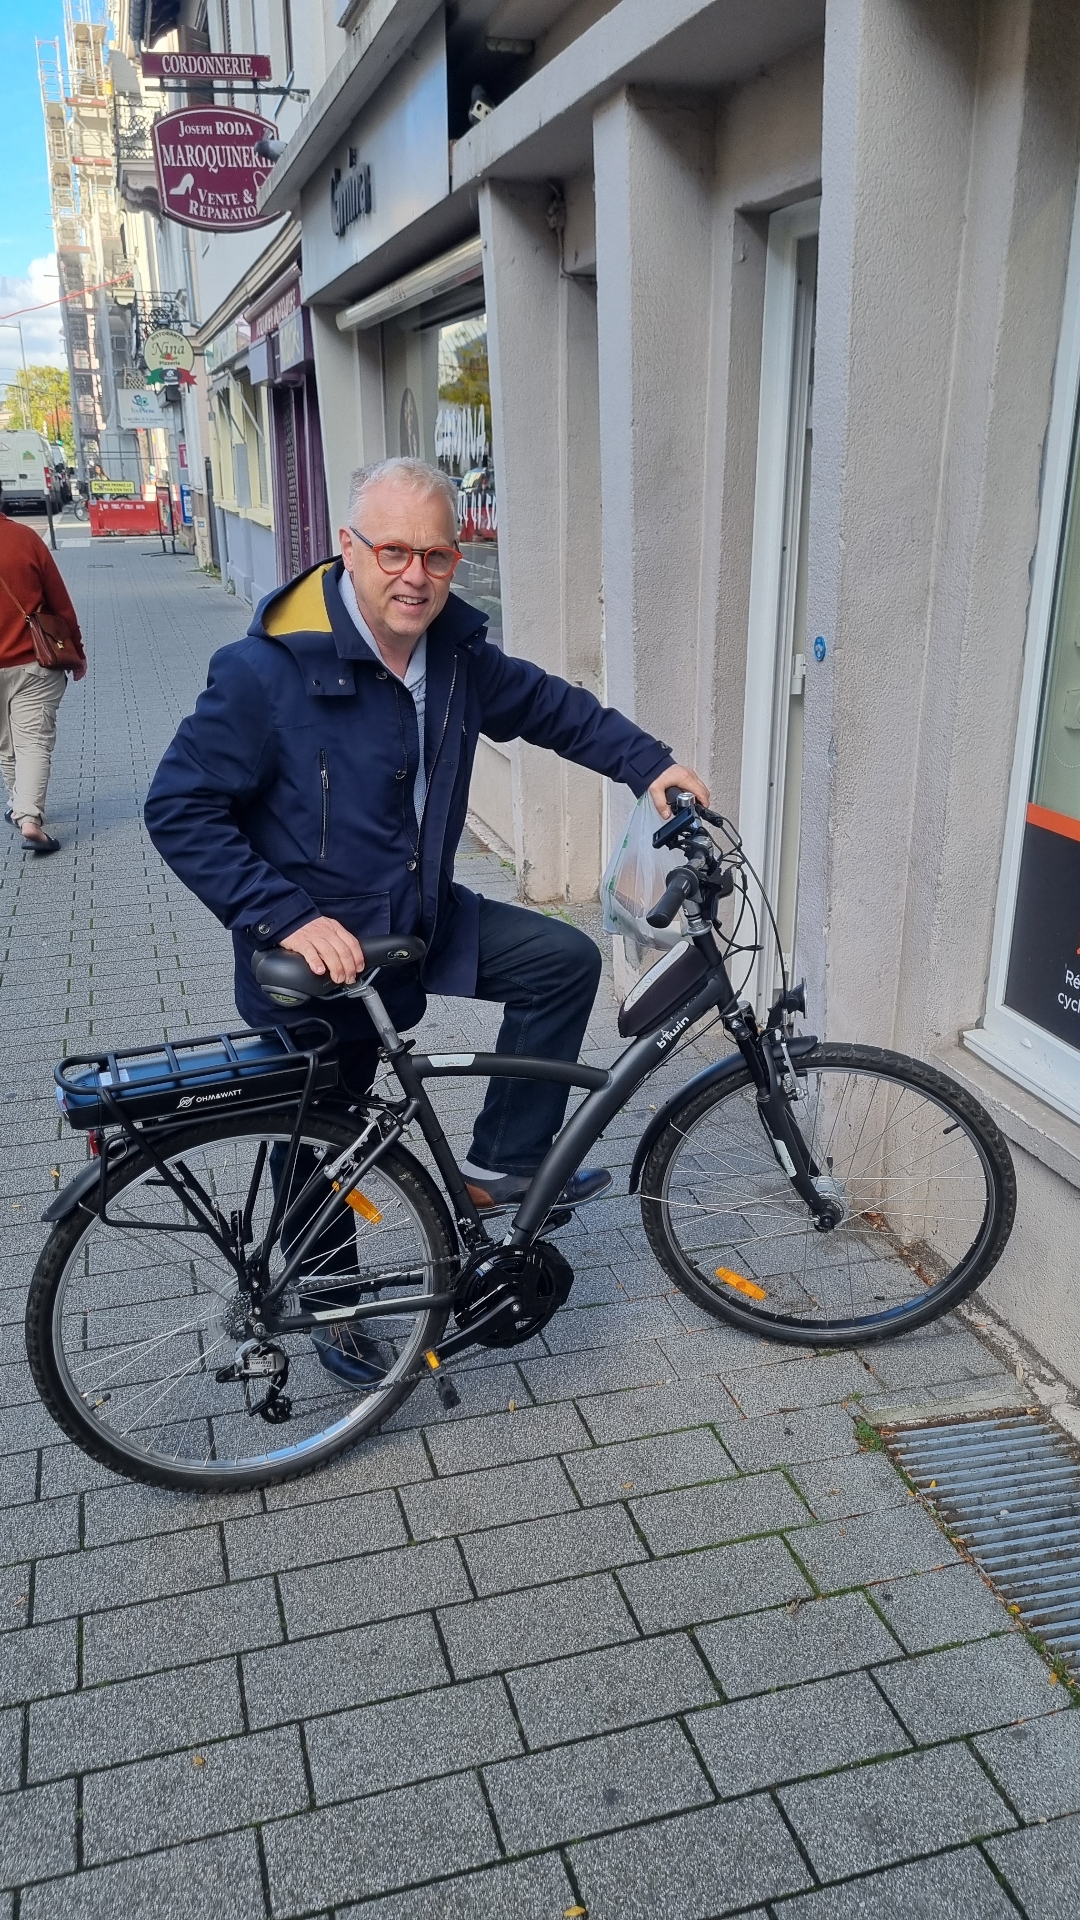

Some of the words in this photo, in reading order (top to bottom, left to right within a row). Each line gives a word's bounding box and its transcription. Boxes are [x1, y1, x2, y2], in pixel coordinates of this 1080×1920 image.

[161, 54, 253, 76] CORDONNERIE
[214, 121, 254, 136] RODA
[160, 144, 276, 174] MAROQUINER
[197, 188, 240, 206] VENTE
[242, 188, 255, 204] &
[188, 199, 257, 220] REPARATIO
[151, 341, 185, 356] Nina
[196, 1089, 242, 1102] OHM&WATT
